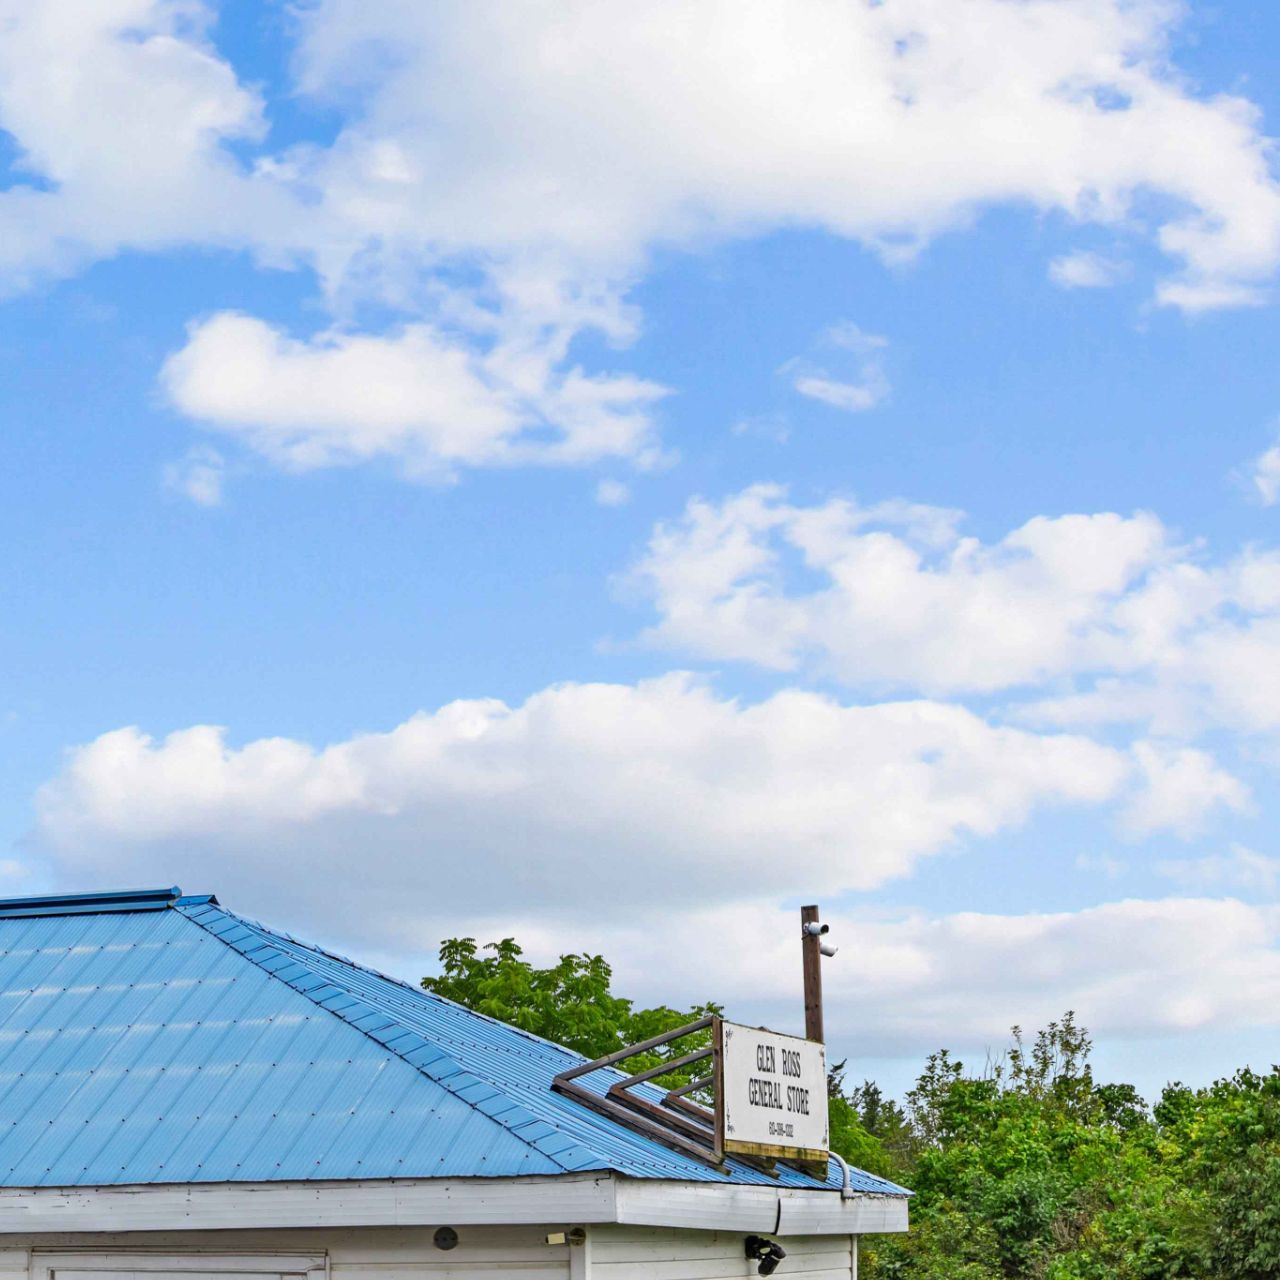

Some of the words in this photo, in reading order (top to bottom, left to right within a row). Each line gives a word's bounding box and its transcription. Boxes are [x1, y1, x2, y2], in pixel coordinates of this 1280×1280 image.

[757, 1044, 776, 1073] GLEN
[782, 1048, 801, 1078] ROSS
[749, 1077, 783, 1110] GENERAL
[787, 1086, 810, 1115] STORE
